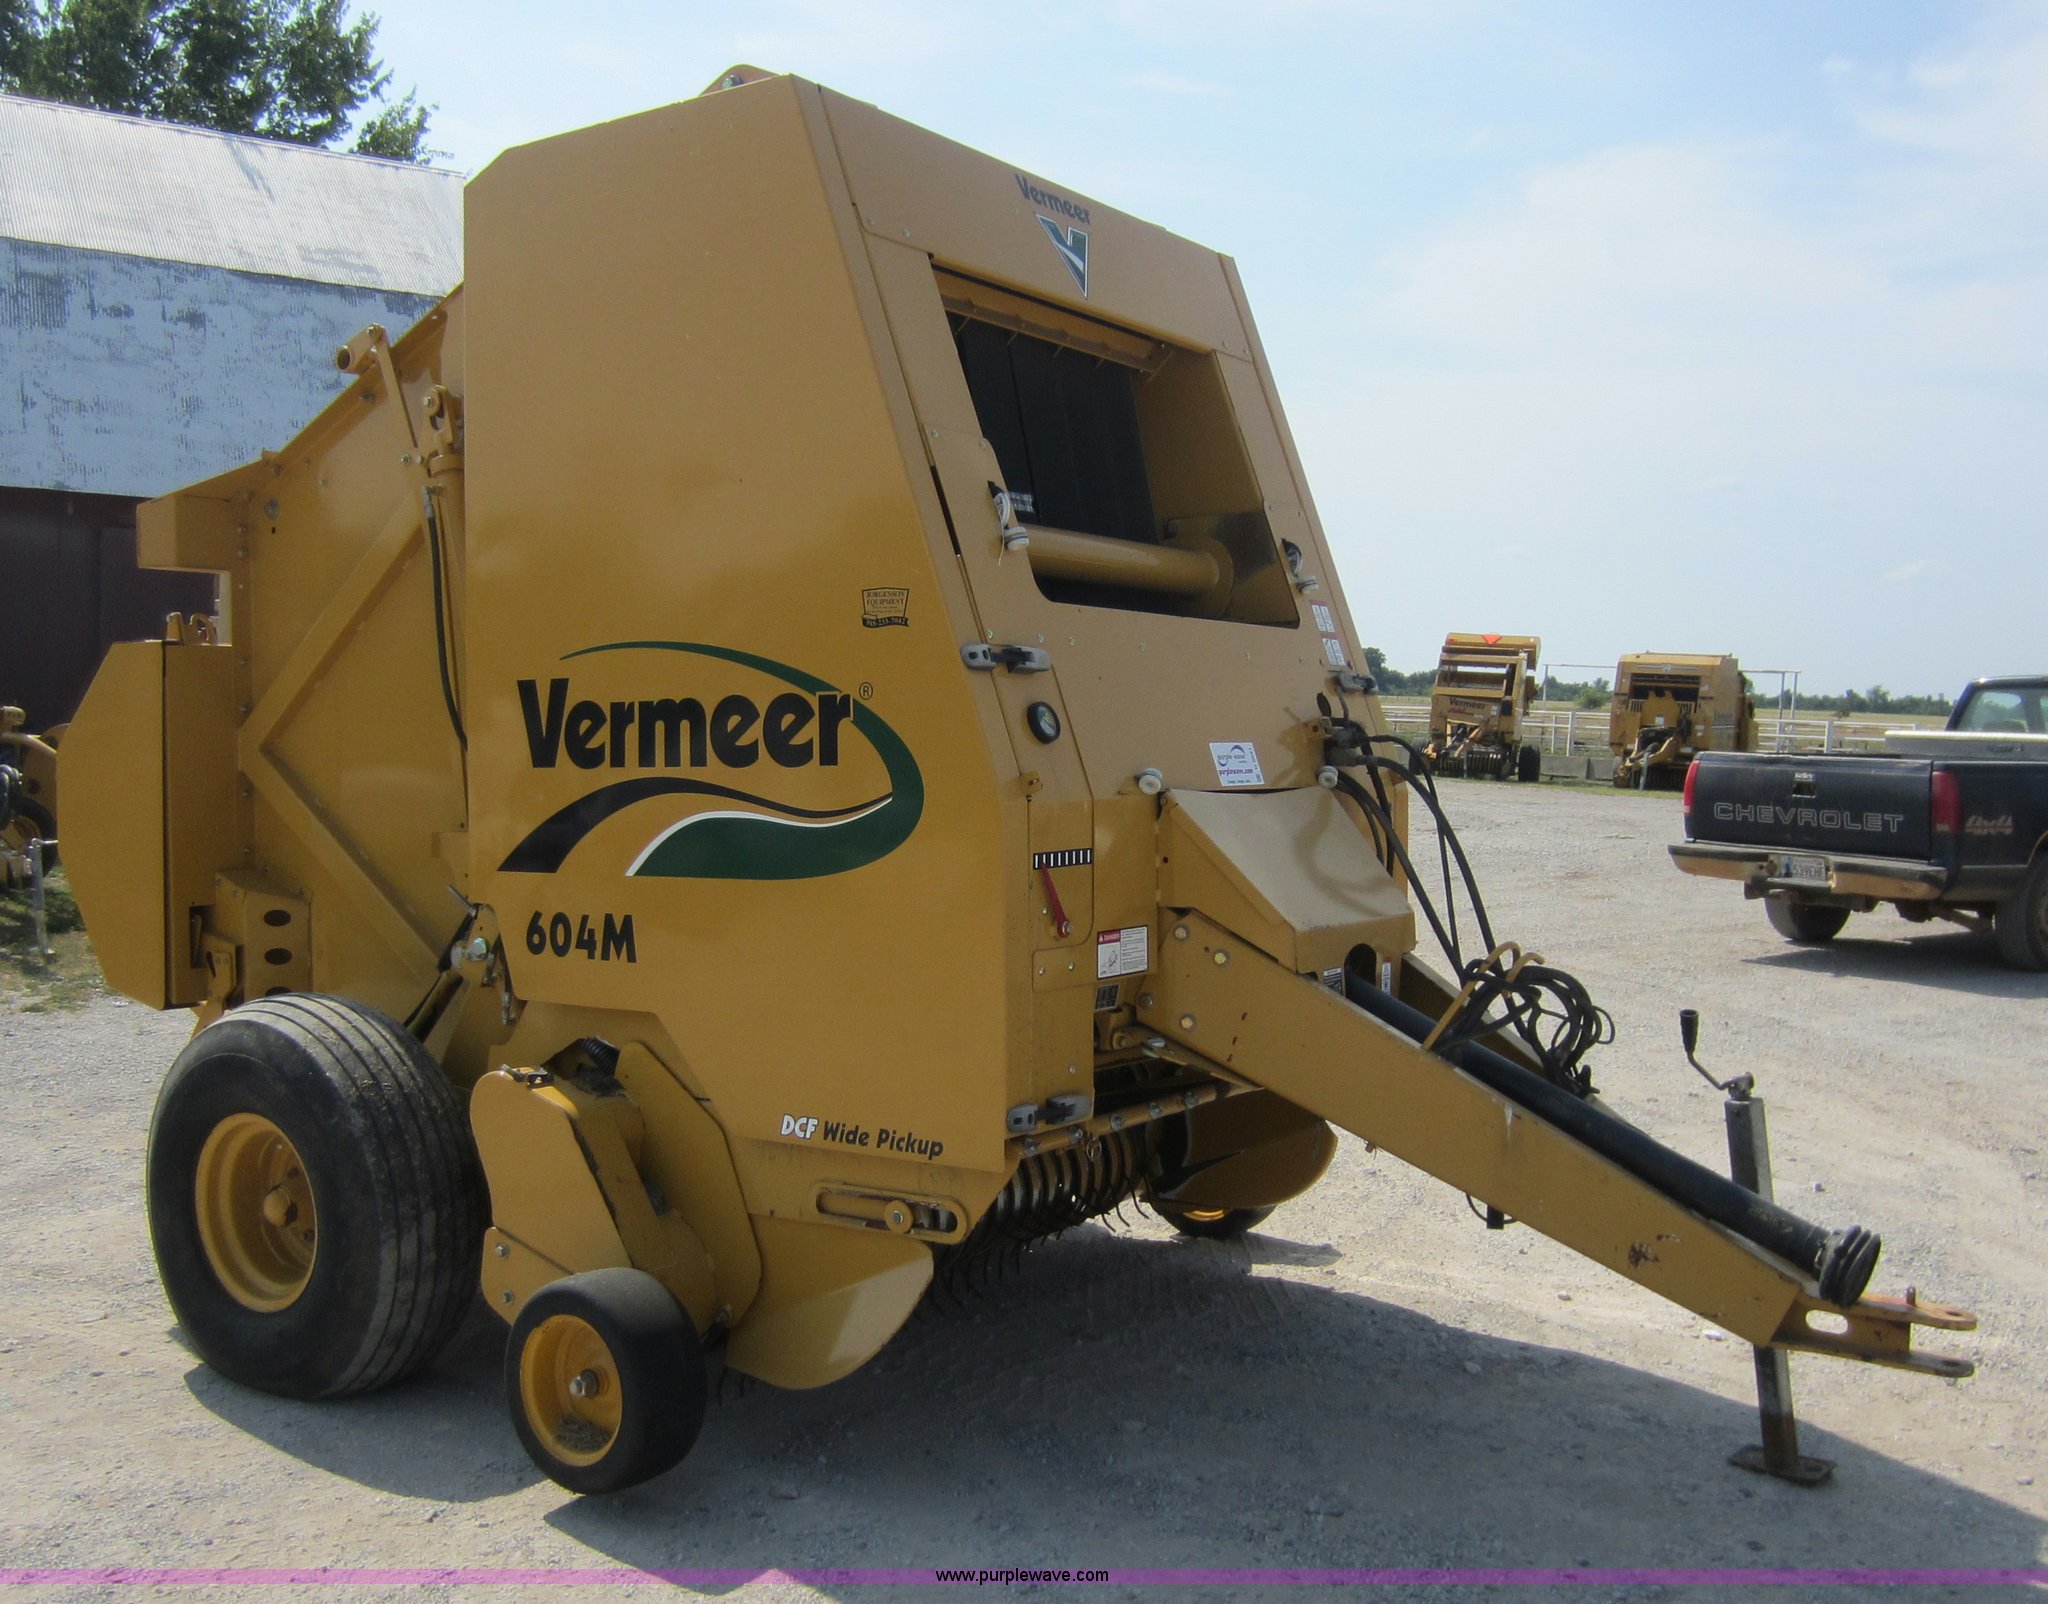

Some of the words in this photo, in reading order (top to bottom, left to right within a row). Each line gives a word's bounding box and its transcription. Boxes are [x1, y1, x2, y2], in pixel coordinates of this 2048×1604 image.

[1013, 173, 1091, 225] Vermeer
[516, 677, 852, 770] Vermeer
[1713, 802, 1904, 833] CHEVROLET
[526, 910, 638, 964] 604M
[780, 1114, 819, 1140] DCF
[823, 1120, 871, 1147] Wide
[876, 1127, 944, 1160] Pickup
